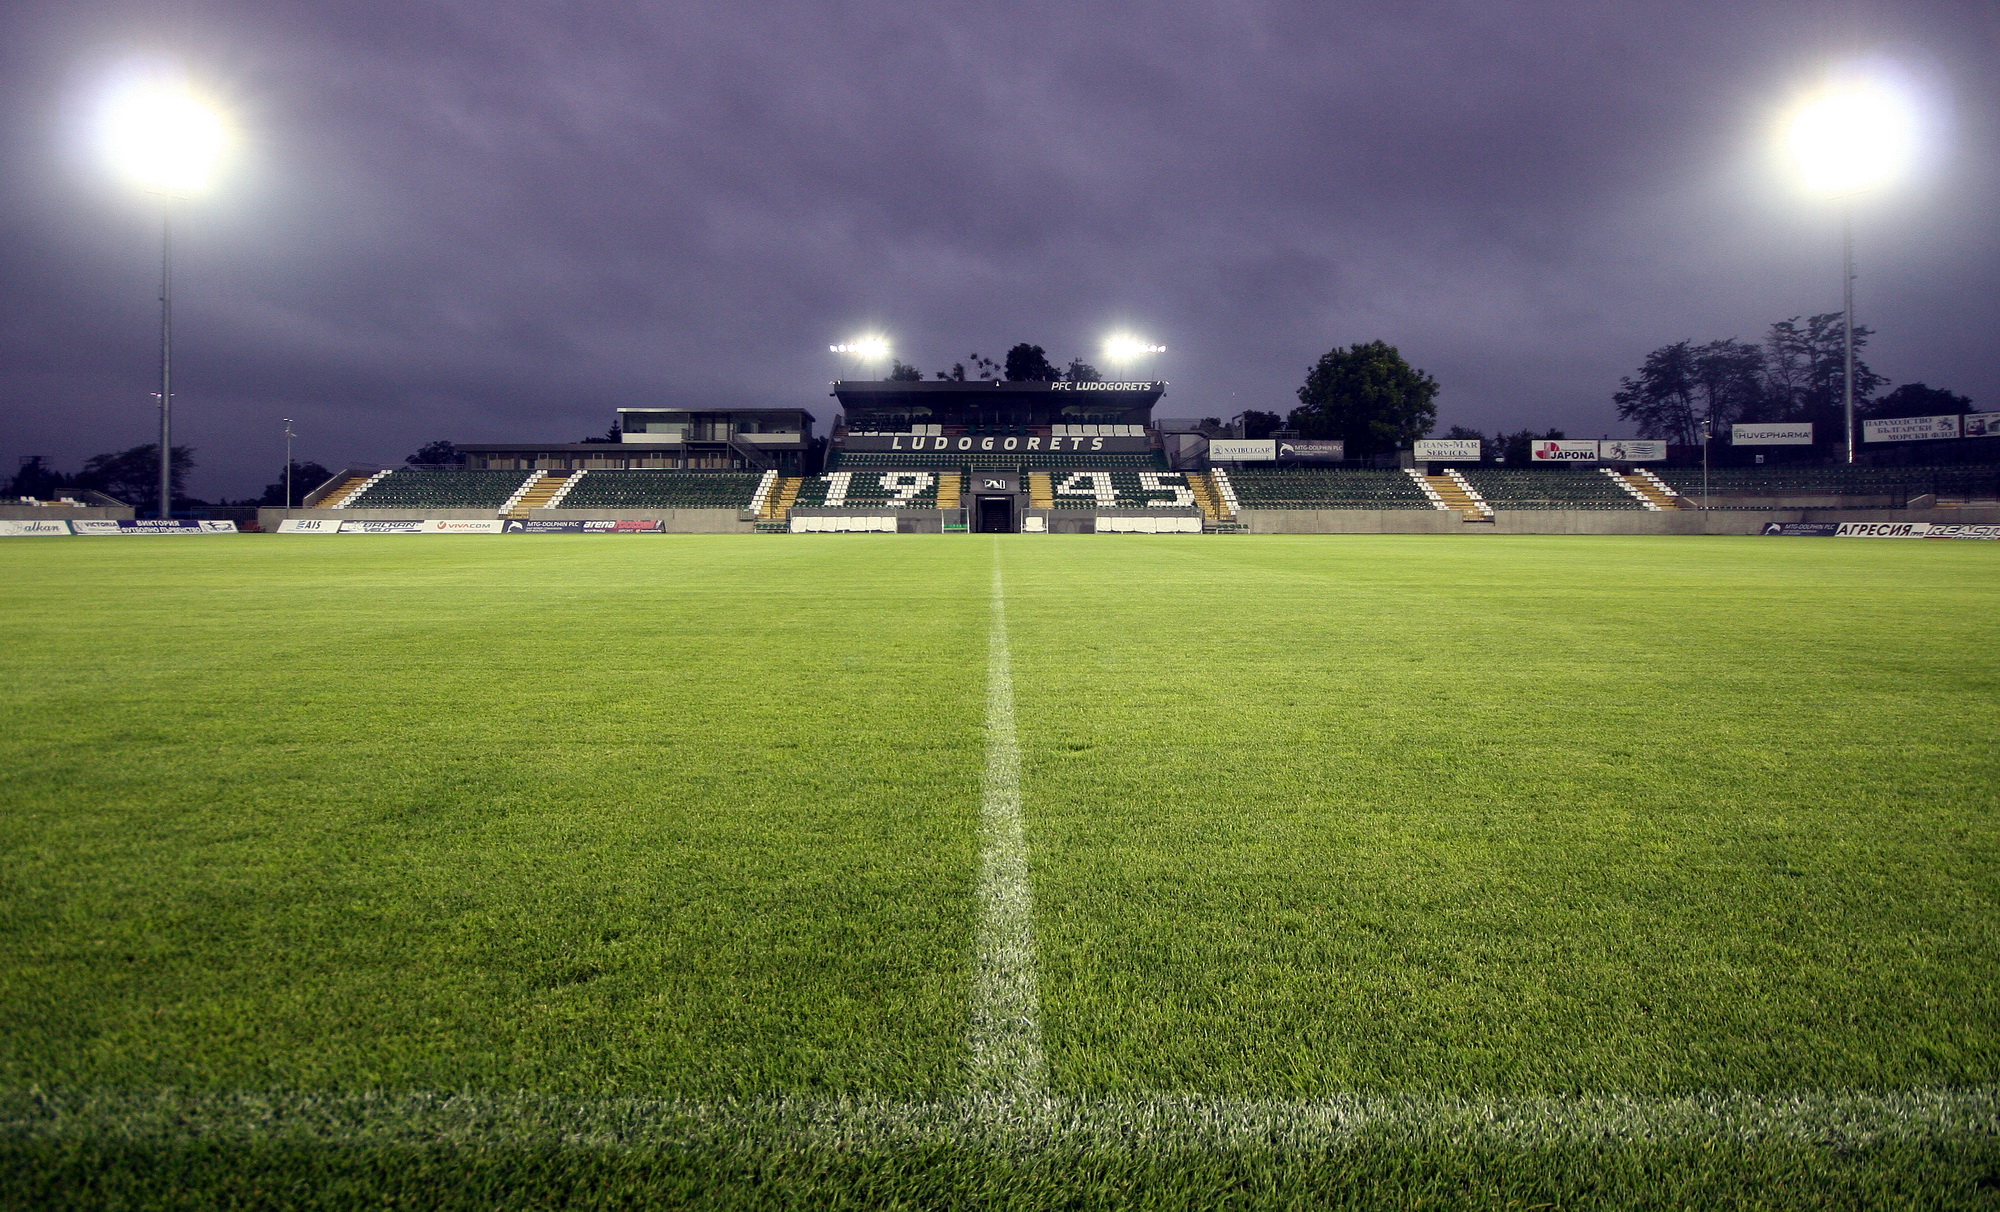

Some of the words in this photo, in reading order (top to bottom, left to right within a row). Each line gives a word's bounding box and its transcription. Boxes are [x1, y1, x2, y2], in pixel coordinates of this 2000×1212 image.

[1051, 381, 1072, 391] PFC
[1076, 381, 1152, 391] LUDOGORETS
[1865, 417, 1932, 427] ПАРАХОДСТВО
[1877, 425, 1932, 434] БЪЛГАРСКИ
[1739, 431, 1809, 439] HUVEPHARMA
[1888, 432, 1928, 441] МОРСКИ
[1931, 431, 1957, 439] ФЛОТ
[891, 436, 1104, 450] LUDOGORETS
[1550, 451, 1595, 460] JAPONA
[305, 520, 322, 530] AIS
[583, 521, 616, 529] arena
[1836, 523, 1913, 537] АГРЕСИЯ
